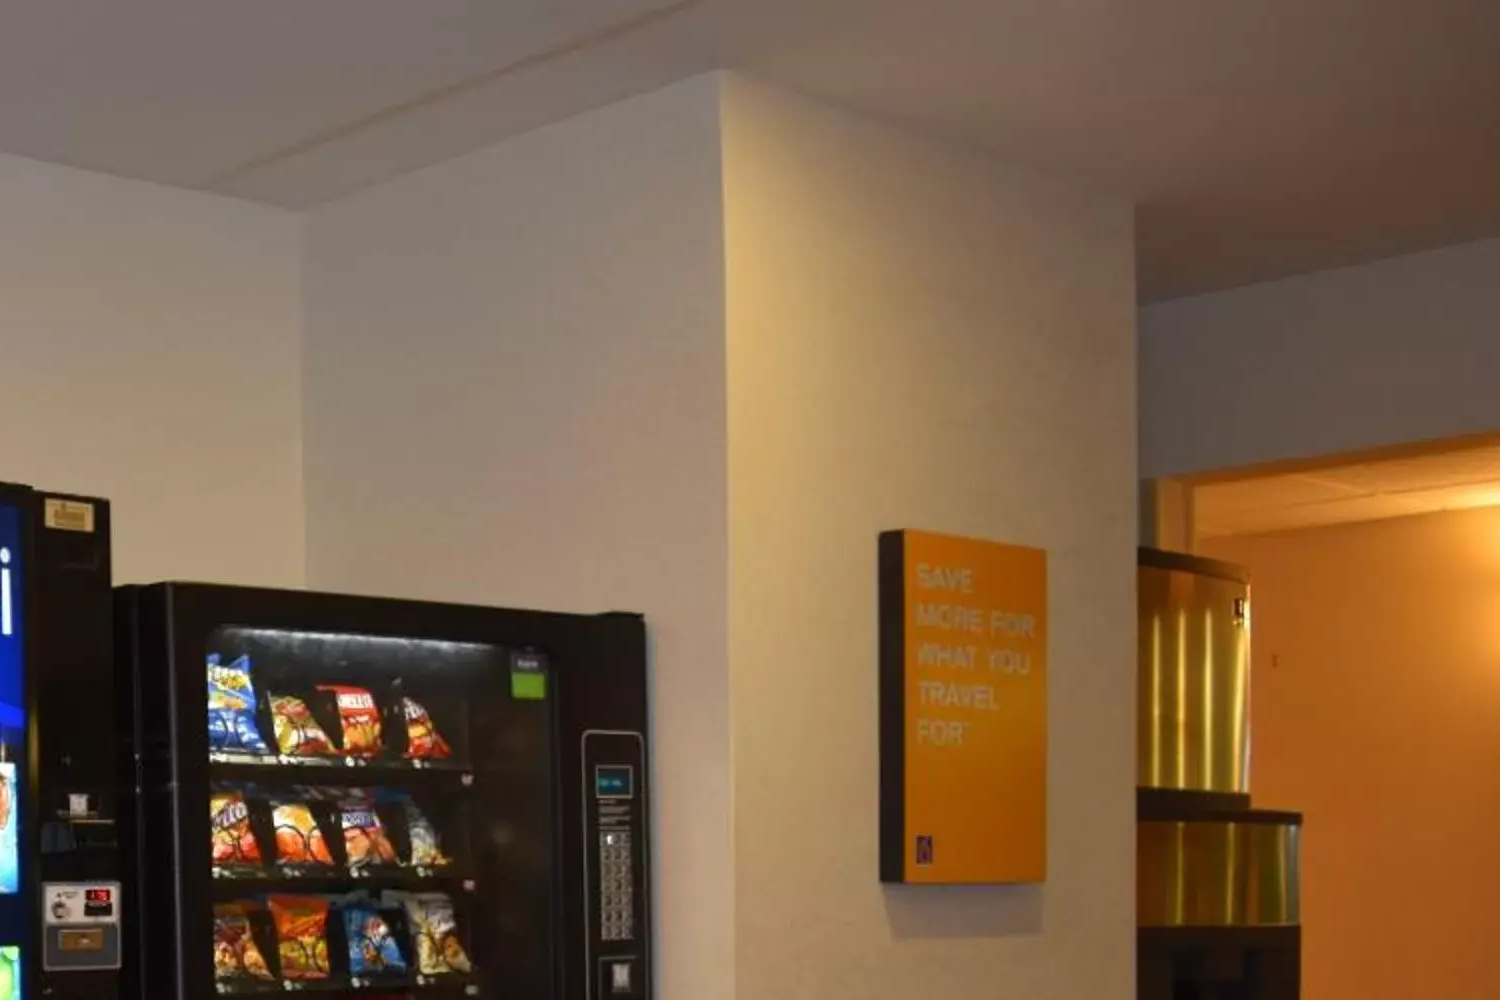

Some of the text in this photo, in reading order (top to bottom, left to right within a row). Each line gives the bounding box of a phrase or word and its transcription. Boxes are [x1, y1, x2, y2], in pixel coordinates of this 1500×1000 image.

[916, 563, 973, 593] SAVE
[915, 602, 1035, 639] MORE FOR
[917, 643, 1031, 675] WHAT YOU
[917, 680, 999, 710] TRAVEL
